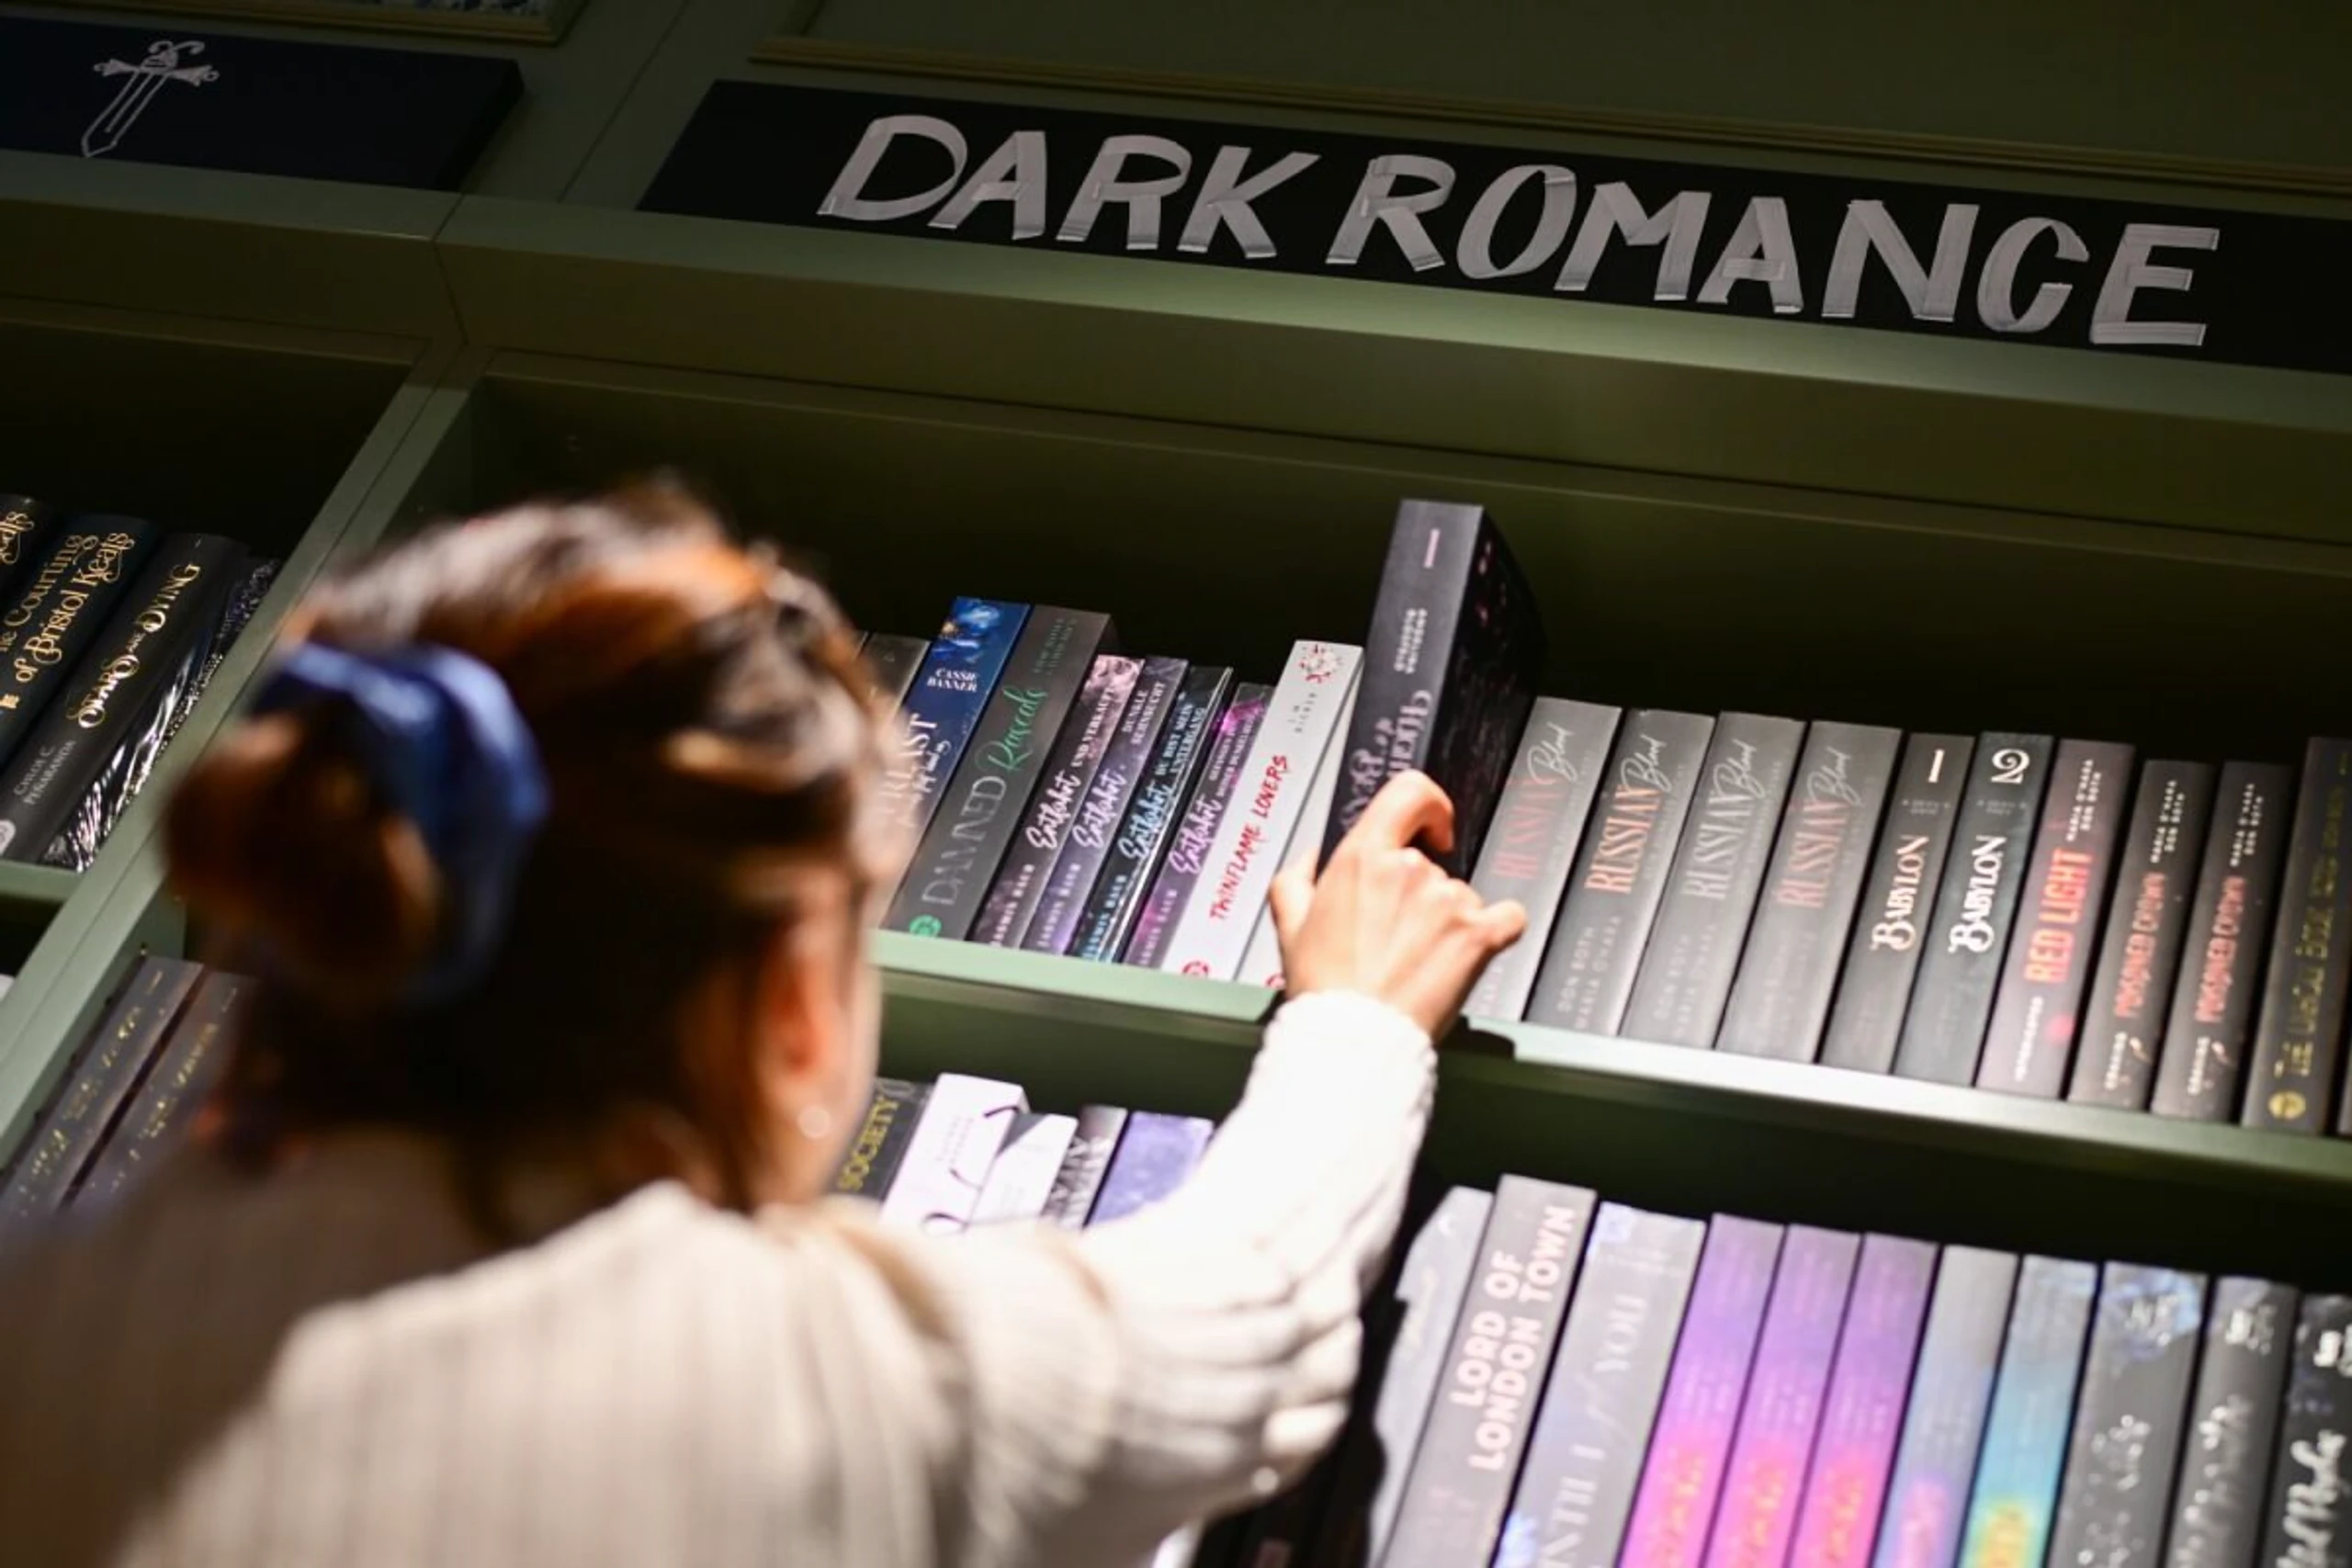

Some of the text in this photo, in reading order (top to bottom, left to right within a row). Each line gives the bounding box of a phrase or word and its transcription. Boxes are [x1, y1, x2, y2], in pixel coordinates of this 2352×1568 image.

[817, 114, 2220, 345] DARK ROMANCE
[4, 535, 99, 626] Courting
[14, 533, 135, 682] of Bristol Keats
[922, 774, 1008, 906] DAMNED
[975, 685, 1047, 773] Rascals
[1250, 754, 1293, 822] LOVERS
[1991, 748, 2030, 784] 2
[1584, 784, 1662, 895] RUSSIAN
[1871, 834, 1930, 953] BABYLON
[1947, 835, 2008, 954] BABYLON
[2038, 848, 2094, 925] LIGHT
[2024, 928, 2075, 984] RED
[1449, 1250, 1525, 1407] LORD OF
[1467, 1205, 1577, 1471] LONDON TOWN
